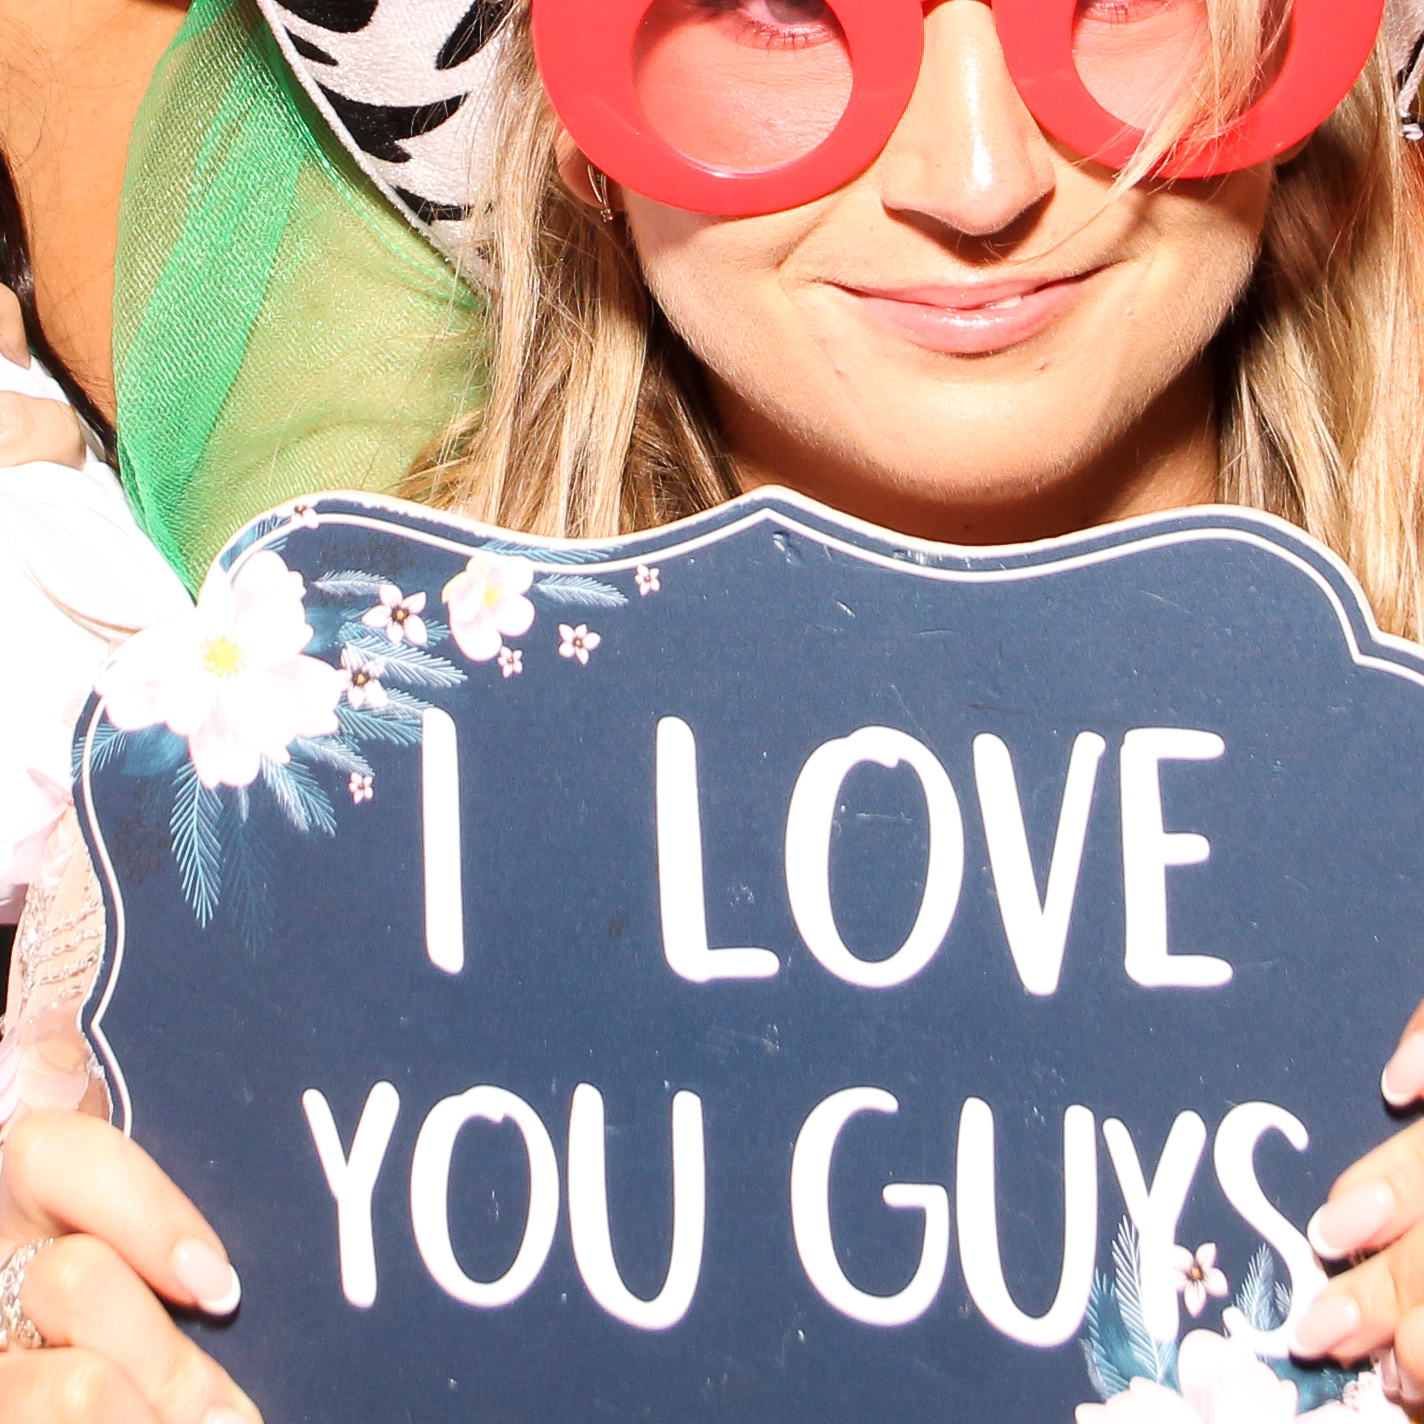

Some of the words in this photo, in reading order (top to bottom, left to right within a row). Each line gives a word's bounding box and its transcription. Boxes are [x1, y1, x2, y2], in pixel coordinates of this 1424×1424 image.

[421, 707, 465, 975] I
[655, 716, 1234, 997] LOVE
[301, 1080, 707, 1332] YOU
[790, 1086, 1328, 1359] GUYS
